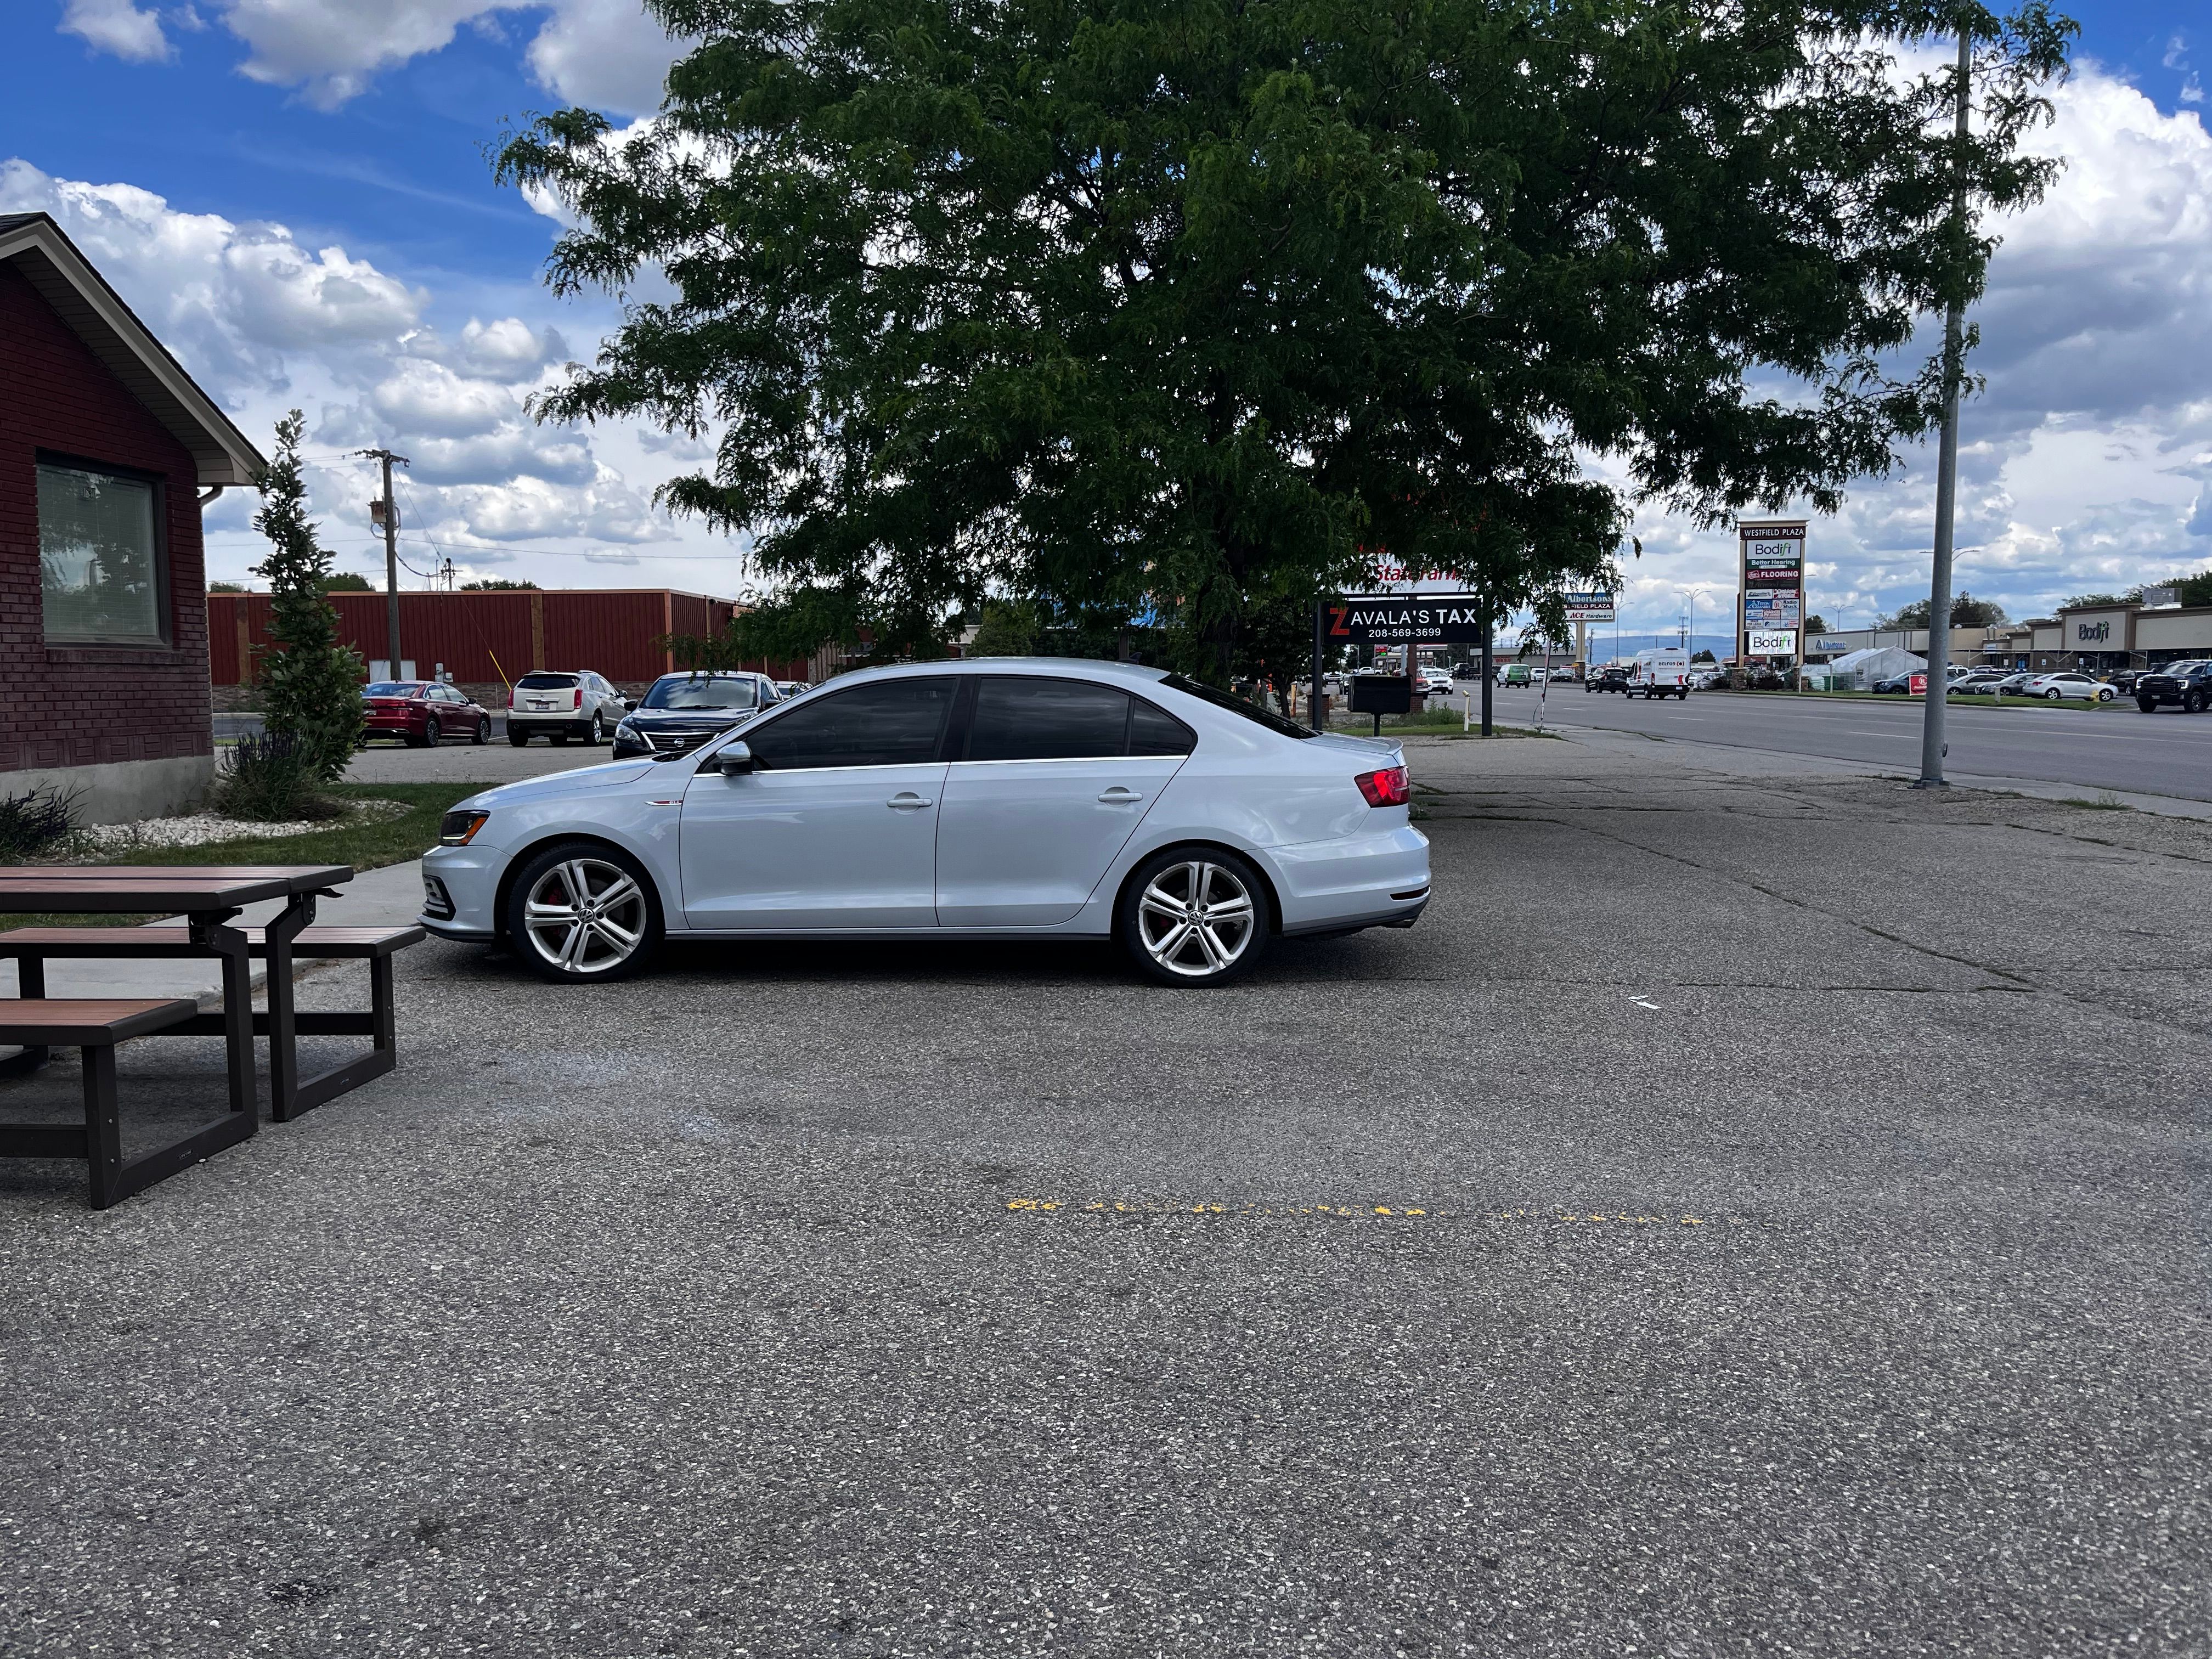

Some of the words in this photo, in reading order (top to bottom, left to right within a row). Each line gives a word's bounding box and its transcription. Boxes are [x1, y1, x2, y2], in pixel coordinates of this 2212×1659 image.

[1756, 543, 1791, 556] Bodifi
[1566, 594, 1612, 602] Albertsons
[1436, 609, 1476, 624] TAX
[1368, 628, 1441, 637] 208-569-3699
[1753, 635, 1791, 650] Bodifi
